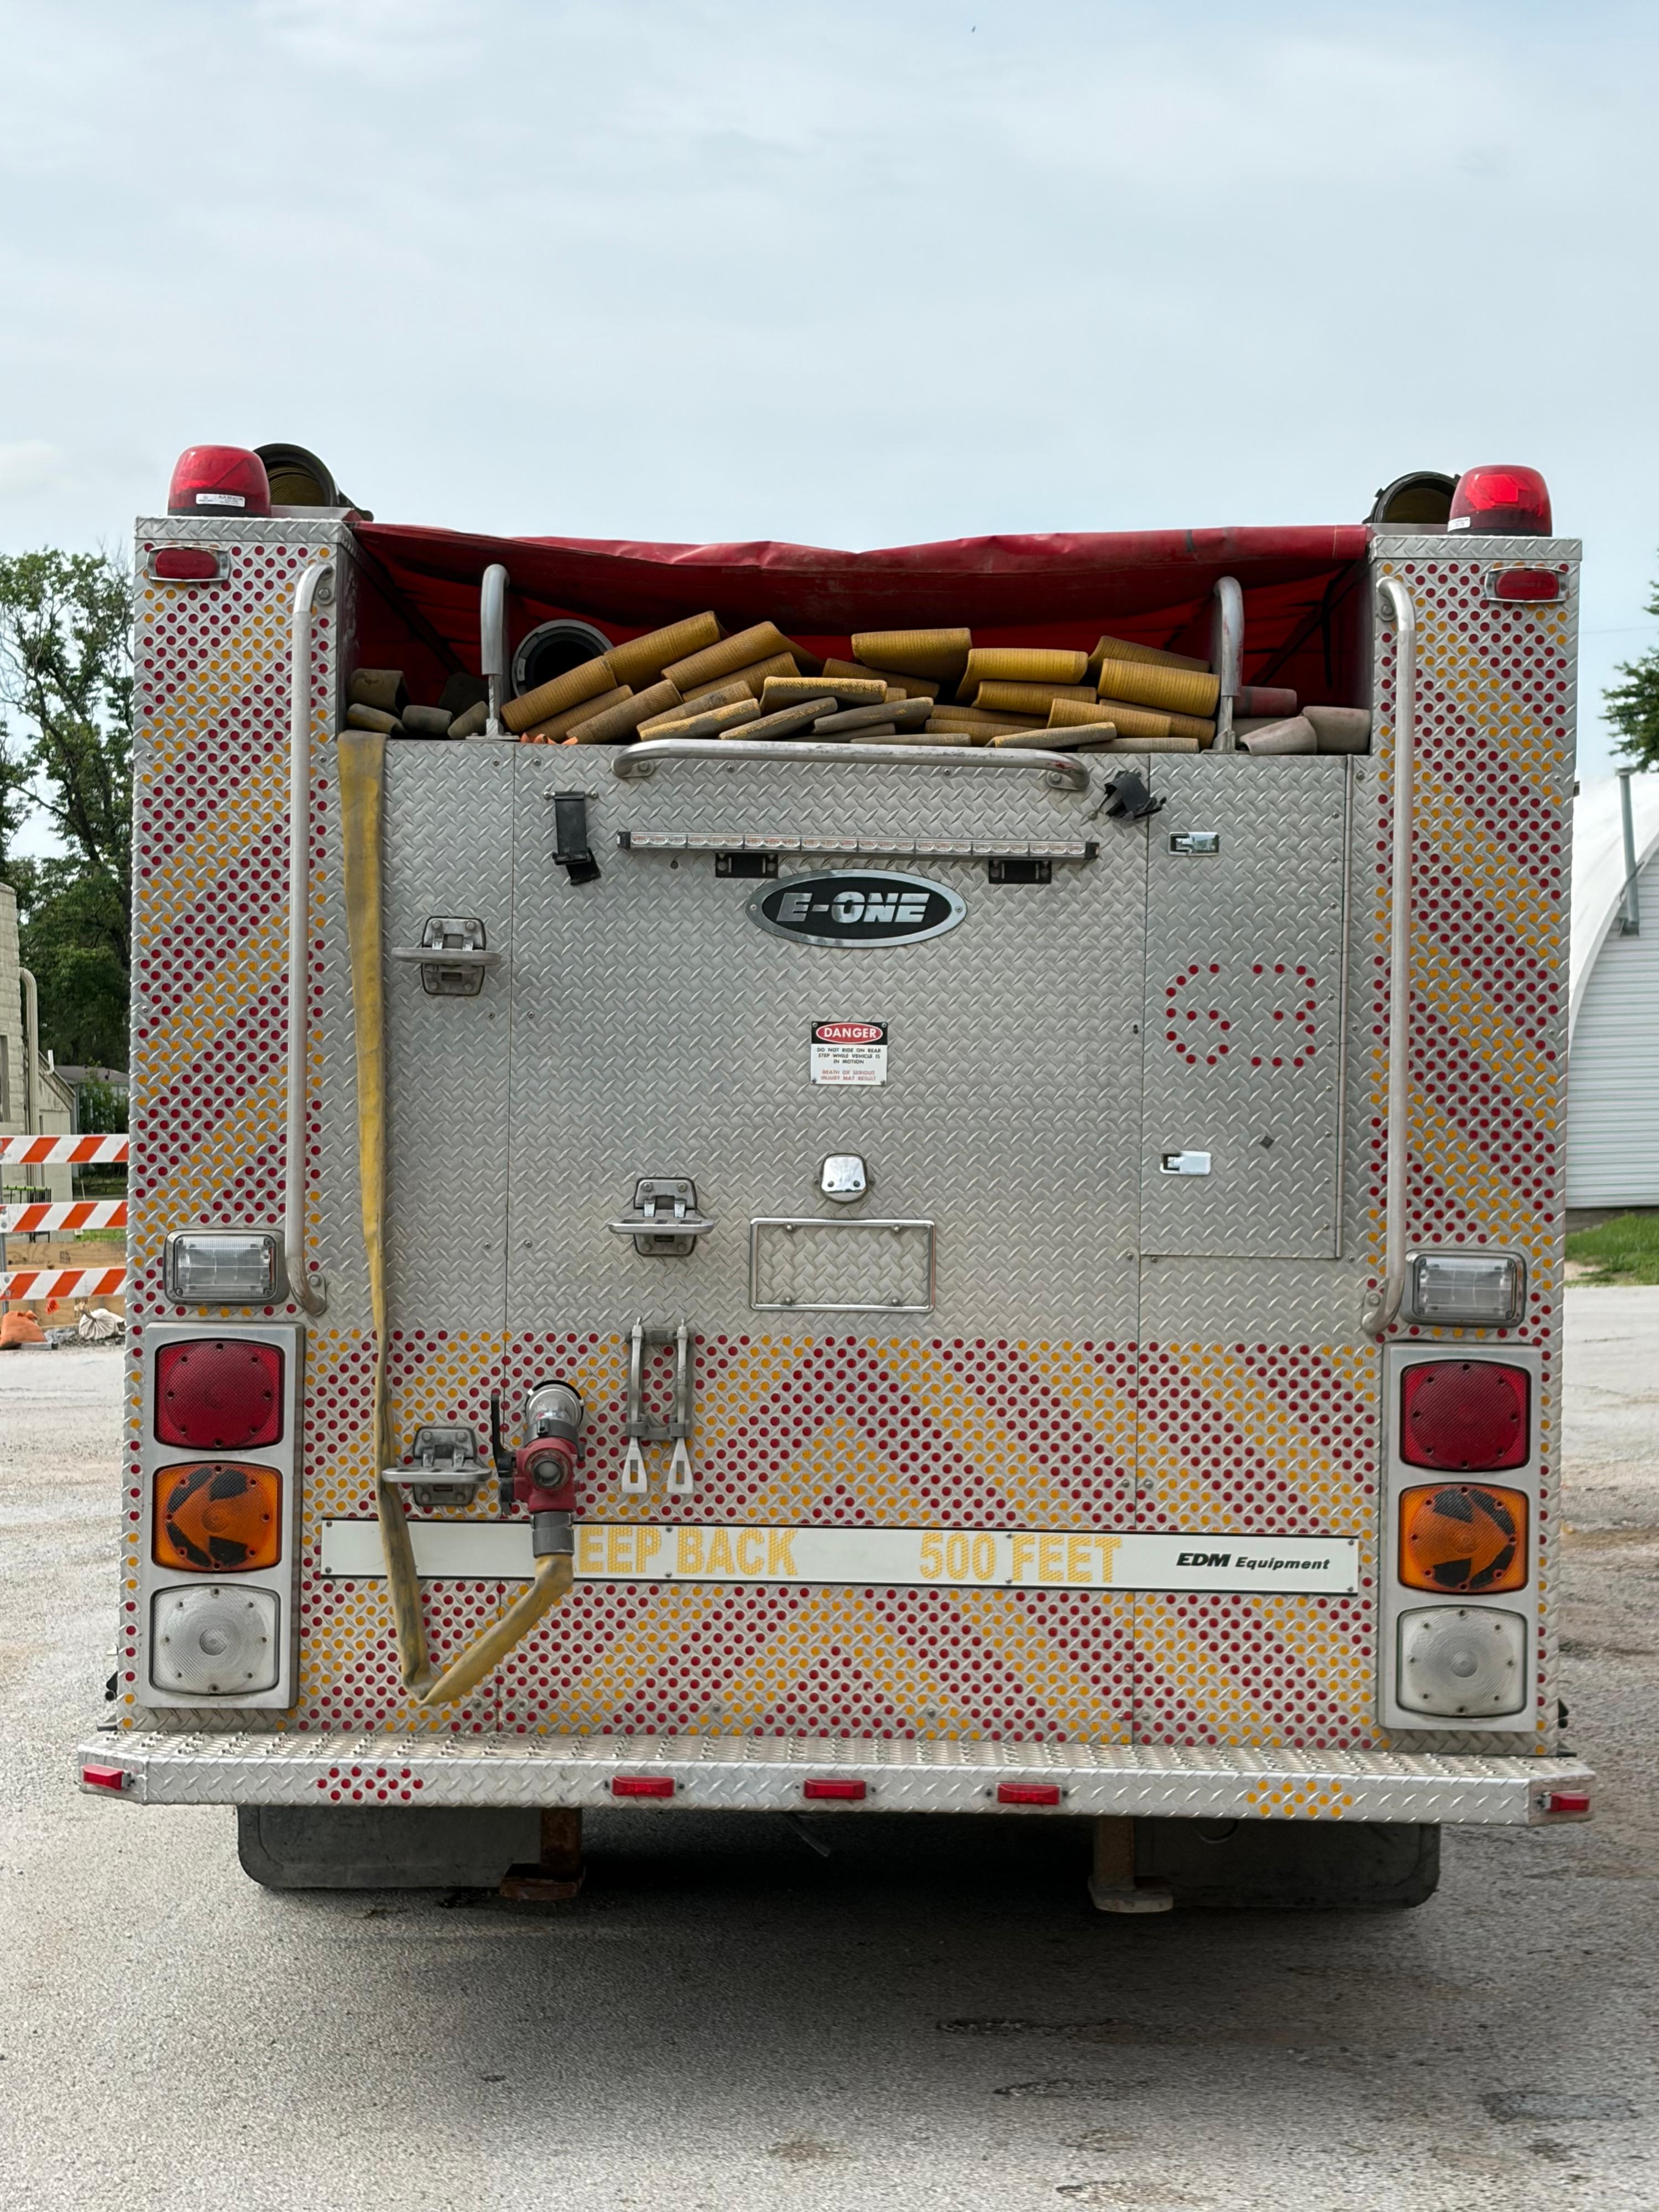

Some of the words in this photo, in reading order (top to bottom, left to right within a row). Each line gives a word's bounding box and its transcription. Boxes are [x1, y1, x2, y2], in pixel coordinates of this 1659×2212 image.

[776, 891, 930, 924] E-ONE
[824, 1027, 877, 1038] DANGER
[573, 1525, 662, 1574] EEP
[676, 1526, 798, 1576] BACK
[919, 1531, 995, 1580] 500
[1011, 1534, 1123, 1583] FEET
[1176, 1552, 1232, 1567] EDM
[1235, 1556, 1330, 1570] Equipment
